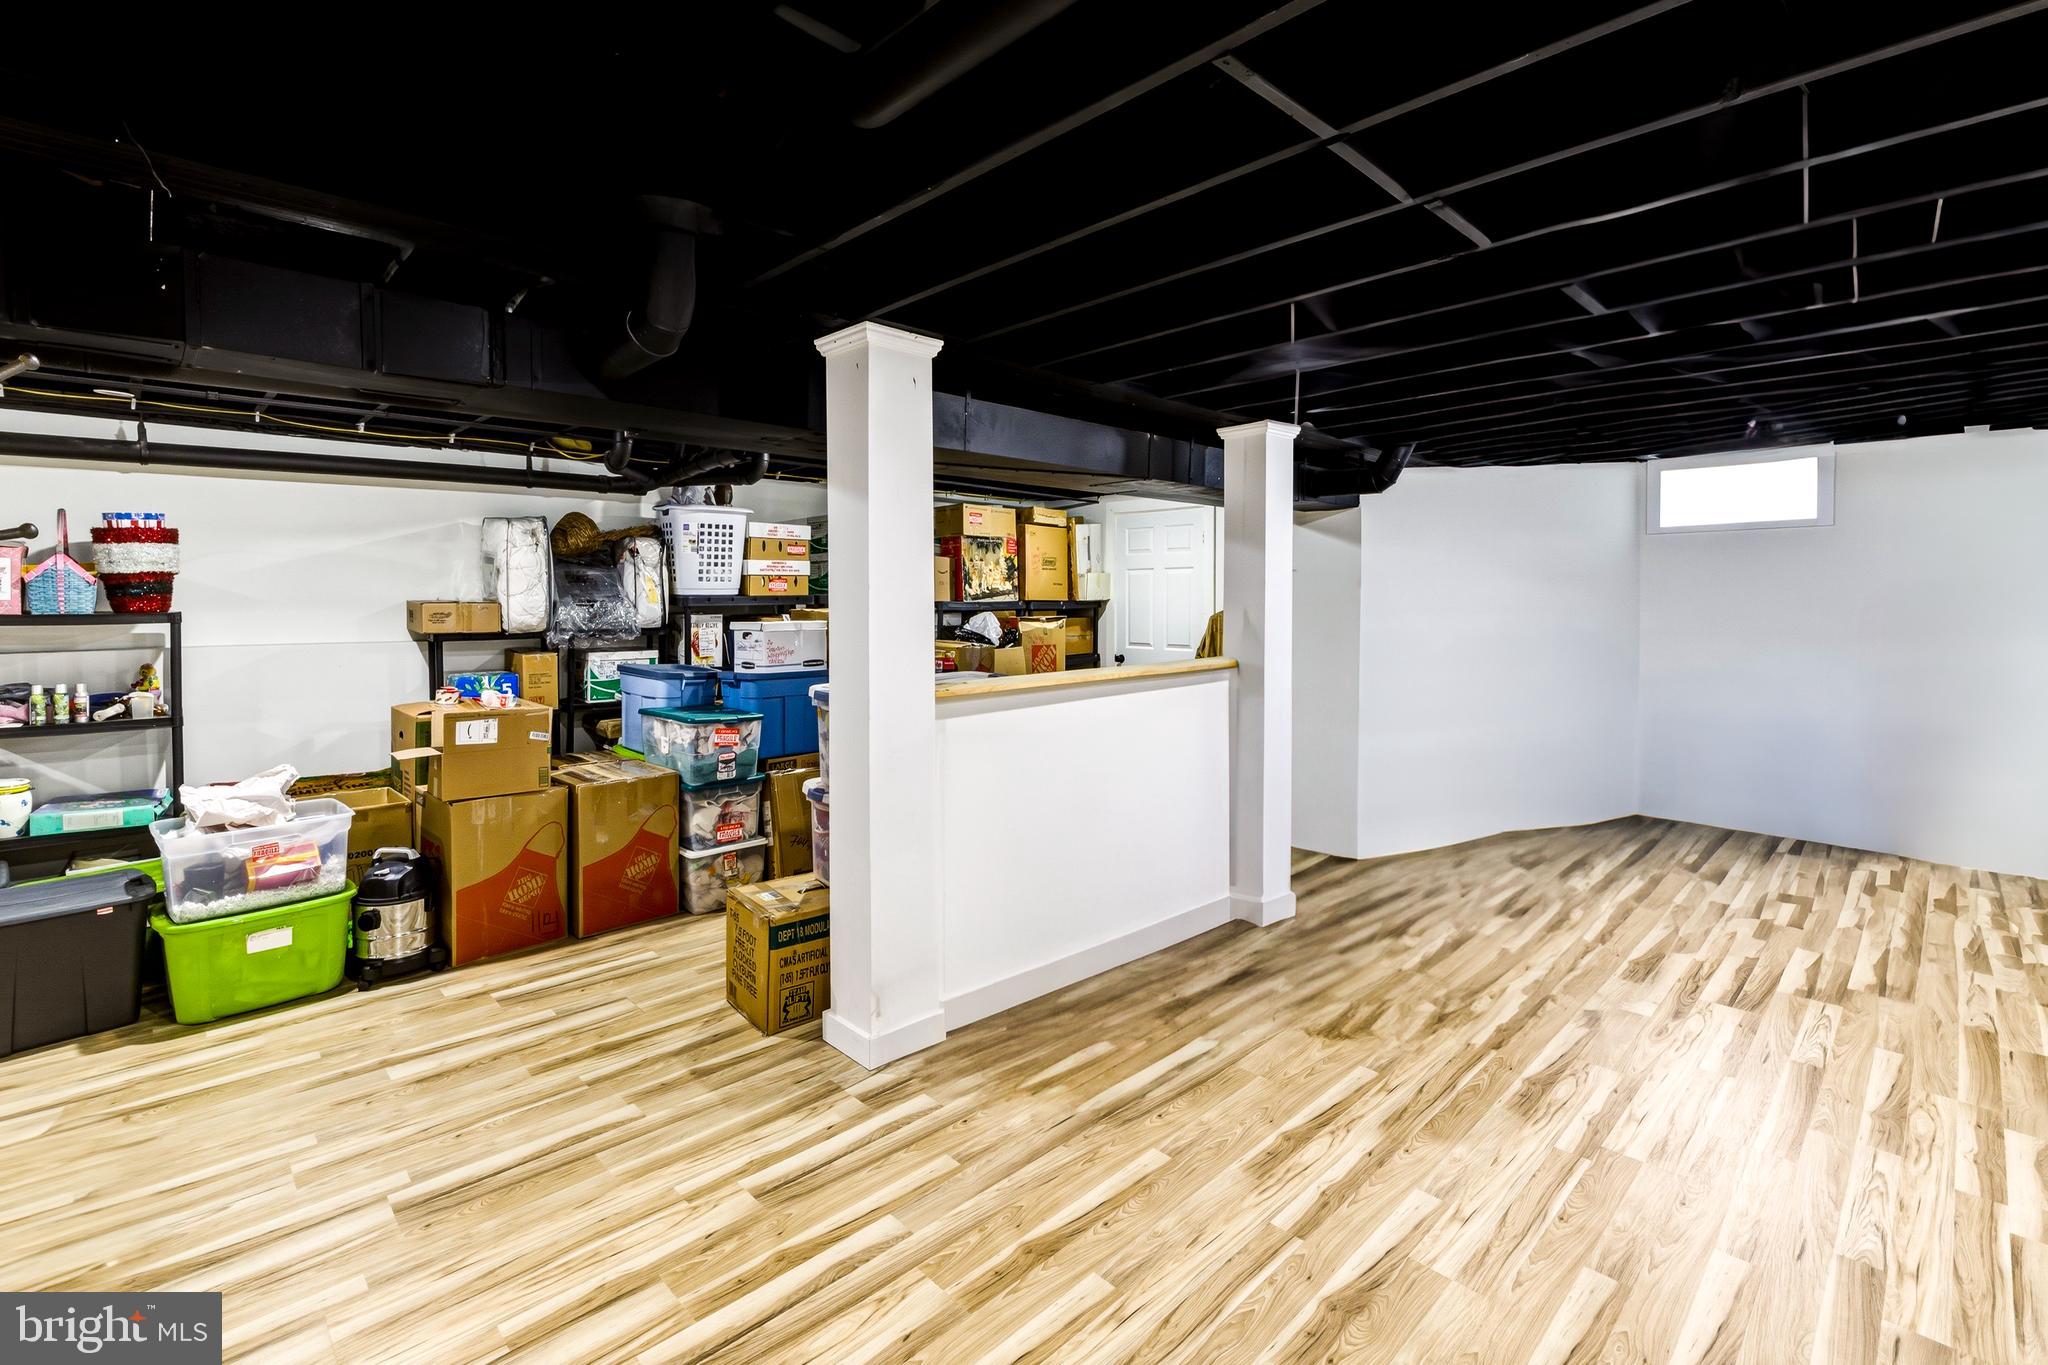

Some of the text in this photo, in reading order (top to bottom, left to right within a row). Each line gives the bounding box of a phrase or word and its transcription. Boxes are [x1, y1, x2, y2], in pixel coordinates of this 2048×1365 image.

[501, 683, 513, 695] 5
[716, 734, 738, 742] FRAGILE
[624, 854, 658, 879] HOME
[508, 875, 545, 902] HOME
[742, 928, 758, 948] FOOT
[777, 928, 796, 942] DEPT
[732, 945, 757, 973] FLOCKED
[796, 947, 829, 964] ARTIFICIAL
[743, 975, 758, 999] TREE
